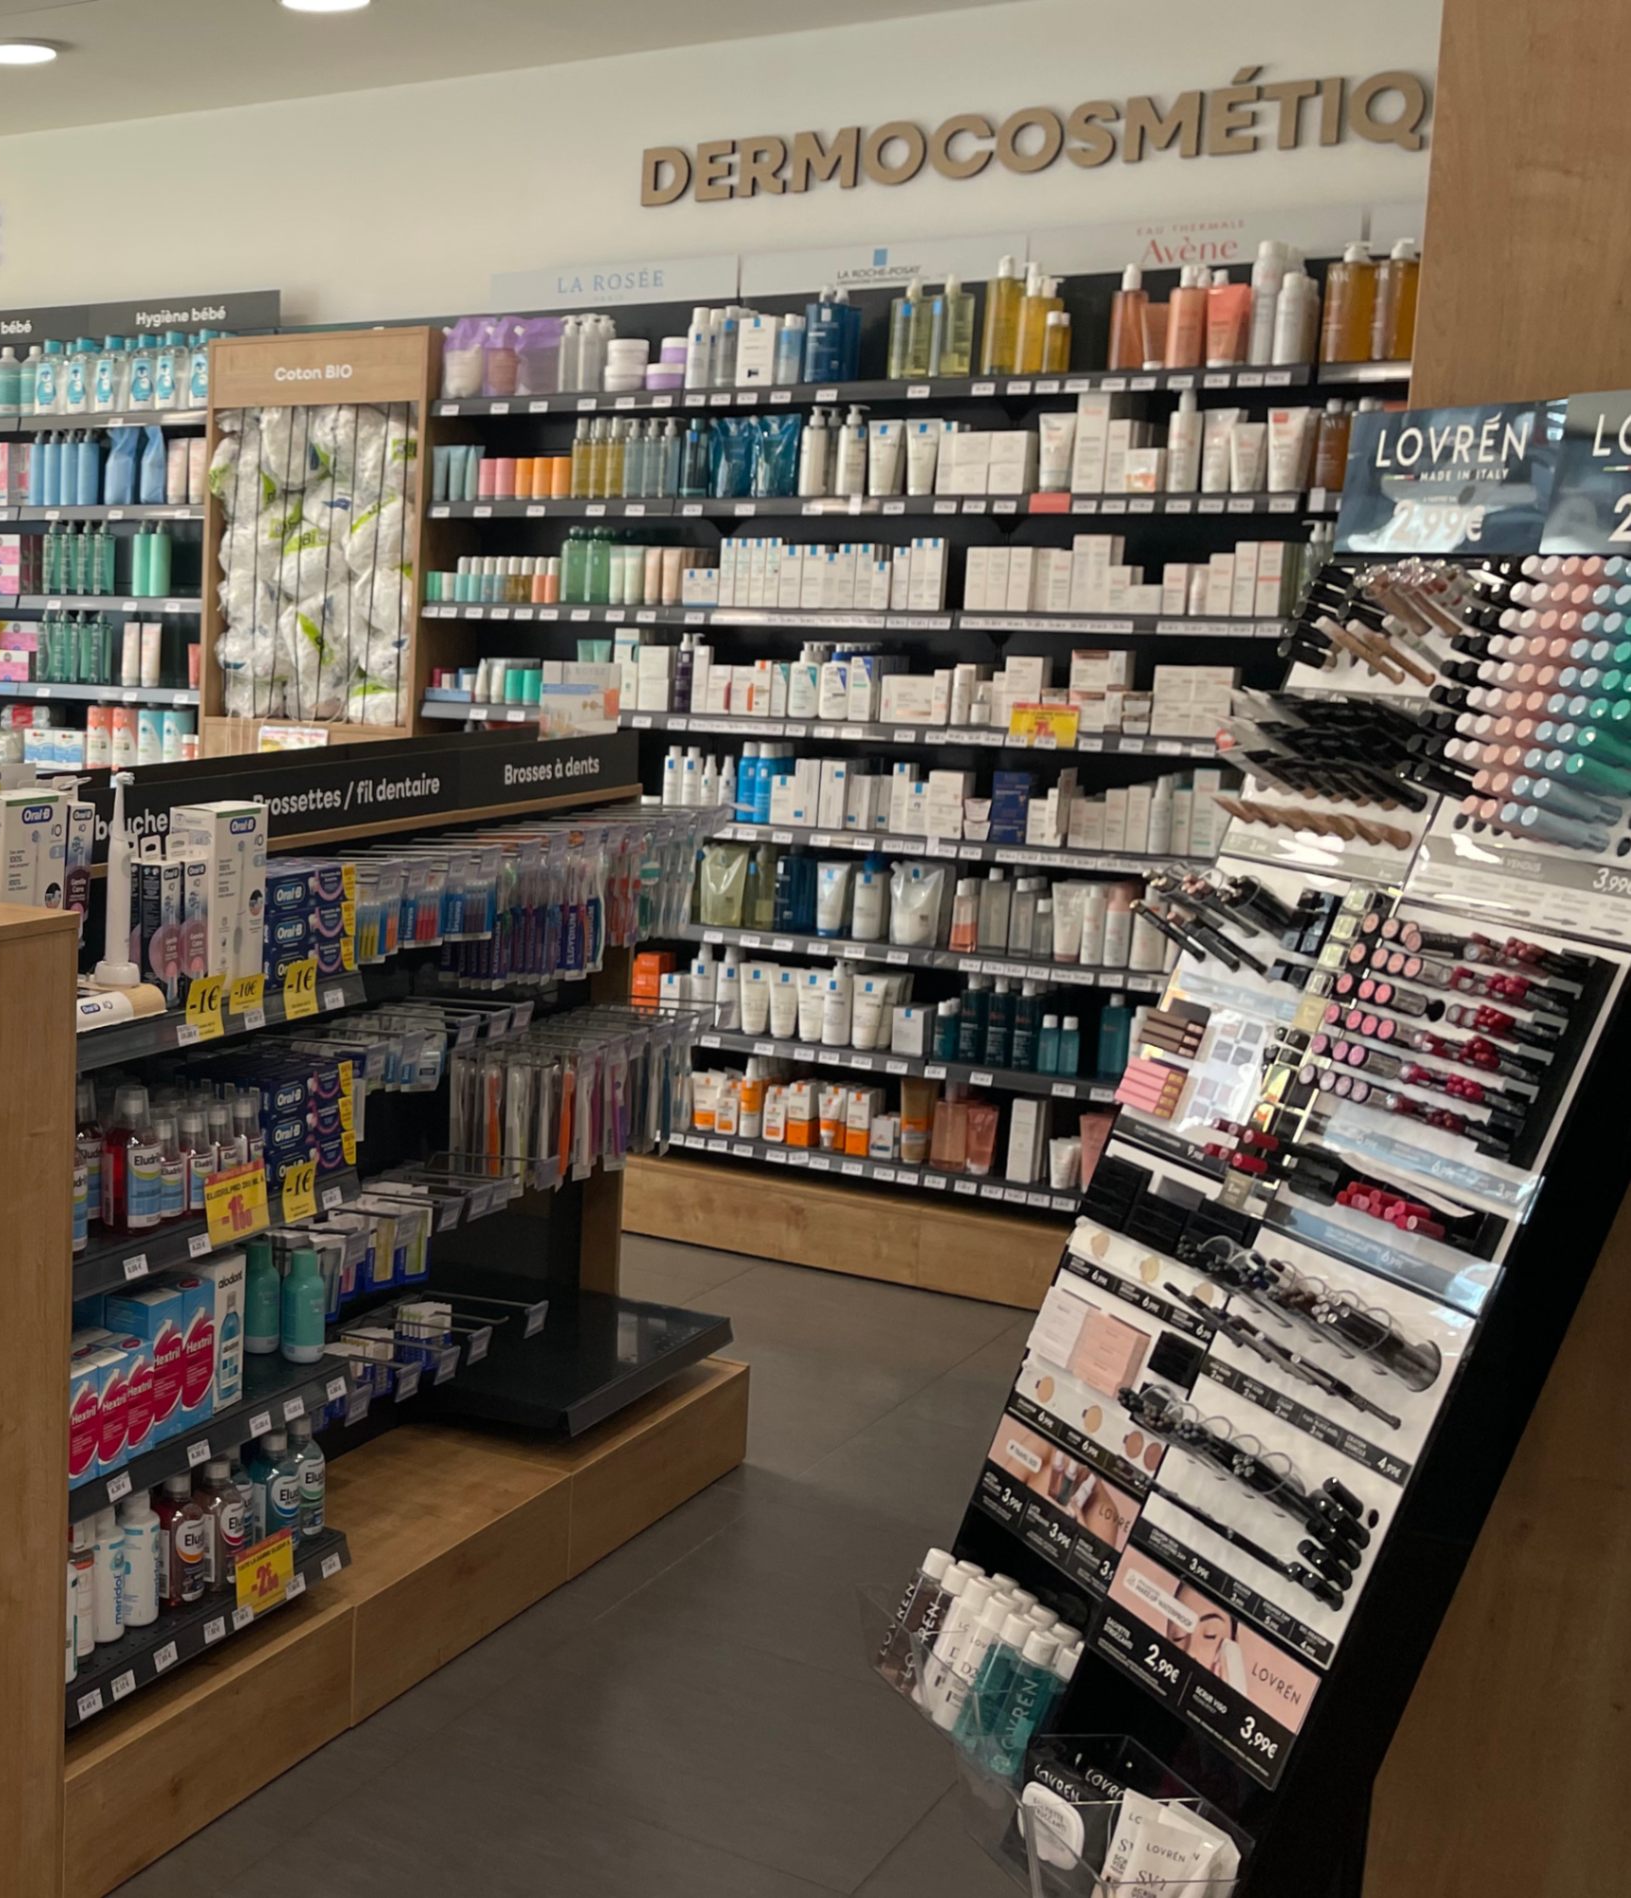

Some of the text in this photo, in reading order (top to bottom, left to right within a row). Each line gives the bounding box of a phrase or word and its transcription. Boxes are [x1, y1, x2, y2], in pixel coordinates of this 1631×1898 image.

[1141, 237, 1238, 266] Avène
[558, 269, 664, 295] LA ROSÉE
[136, 306, 226, 328] Hygiène bébé
[1, 320, 32, 335] bébé
[274, 364, 353, 382] Coton BIO
[1375, 411, 1529, 469] LOVRÉN
[1420, 467, 1510, 482] MADE IN ITALY
[504, 756, 599, 786] Brosses à dents
[356, 781, 374, 805] fil
[376, 773, 440, 802] dentaire
[23, 807, 51, 822] Oral-B
[95, 808, 169, 841] buche
[232, 818, 255, 832] Oral-B
[276, 887, 303, 902] Oral-B
[277, 922, 303, 939] Oral-B
[234, 980, 257, 997] -10€
[287, 965, 314, 994] -1€
[190, 987, 218, 1014] -1€
[277, 1090, 302, 1107] Oral-B
[275, 1124, 301, 1141] Oral-B
[285, 1168, 314, 1195] -1€
[186, 1333, 213, 1354] Hextril
[154, 1349, 180, 1367] Hextril
[127, 1380, 152, 1398] Hextril
[102, 1394, 128, 1413] Hextril
[71, 1405, 97, 1425] Hextril
[1144, 1643, 1181, 1684] 2,99€
[1252, 1662, 1302, 1705] LOVRÉN
[1240, 1716, 1278, 1759] 3,99€
[1147, 1843, 1186, 1863] LOVRÉN
